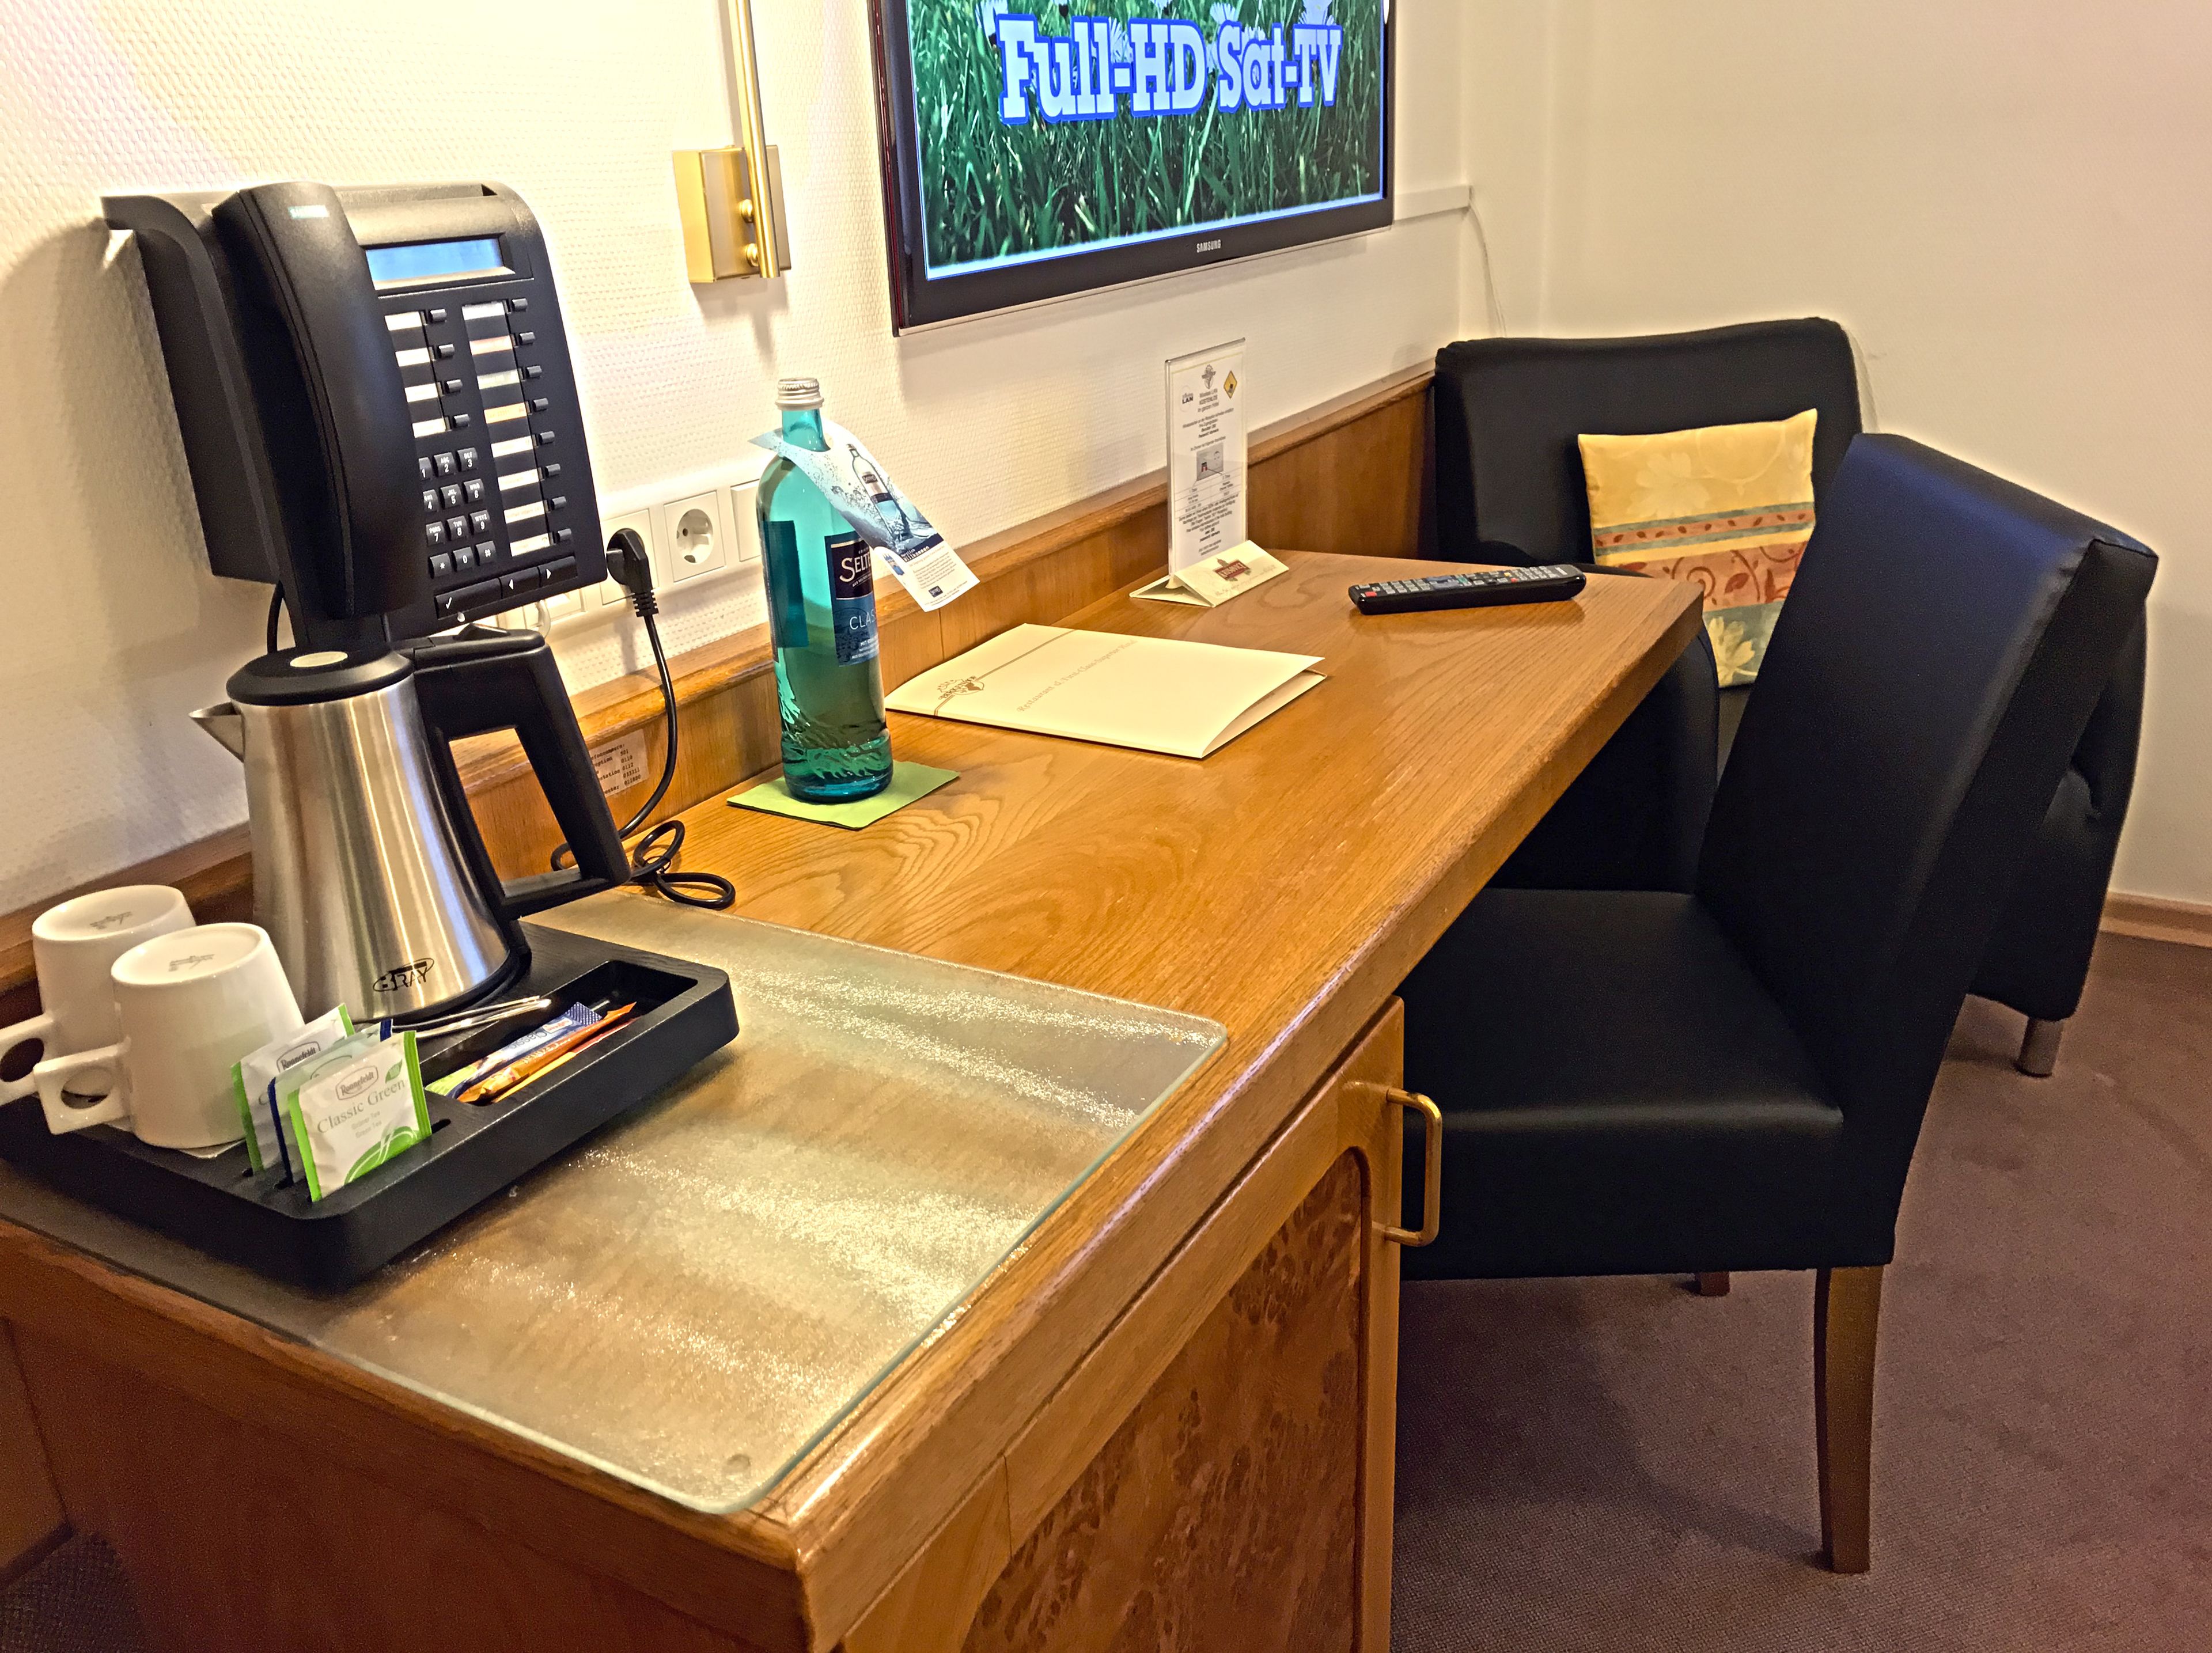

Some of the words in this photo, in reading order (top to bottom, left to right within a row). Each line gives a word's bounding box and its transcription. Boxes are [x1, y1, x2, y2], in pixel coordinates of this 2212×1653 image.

[997, 14, 1208, 123] Full-HD
[1218, 21, 1342, 111] Sat-TV
[1196, 239, 1221, 253] SAMSUNG
[467, 459, 473, 468] 3
[422, 468, 426, 478] 1
[444, 464, 449, 473] 2
[474, 490, 479, 499] 6
[450, 496, 456, 505] 5
[427, 501, 433, 510] 4
[480, 521, 485, 530] 9
[457, 527, 462, 536] 8
[434, 533, 439, 542] 7
[463, 555, 468, 564] 0
[280, 1047, 316, 1070] Ronnefeldt
[339, 1071, 375, 1096] Ronnefeldt
[317, 1102, 365, 1133] Classic
[368, 1080, 406, 1106] Green
